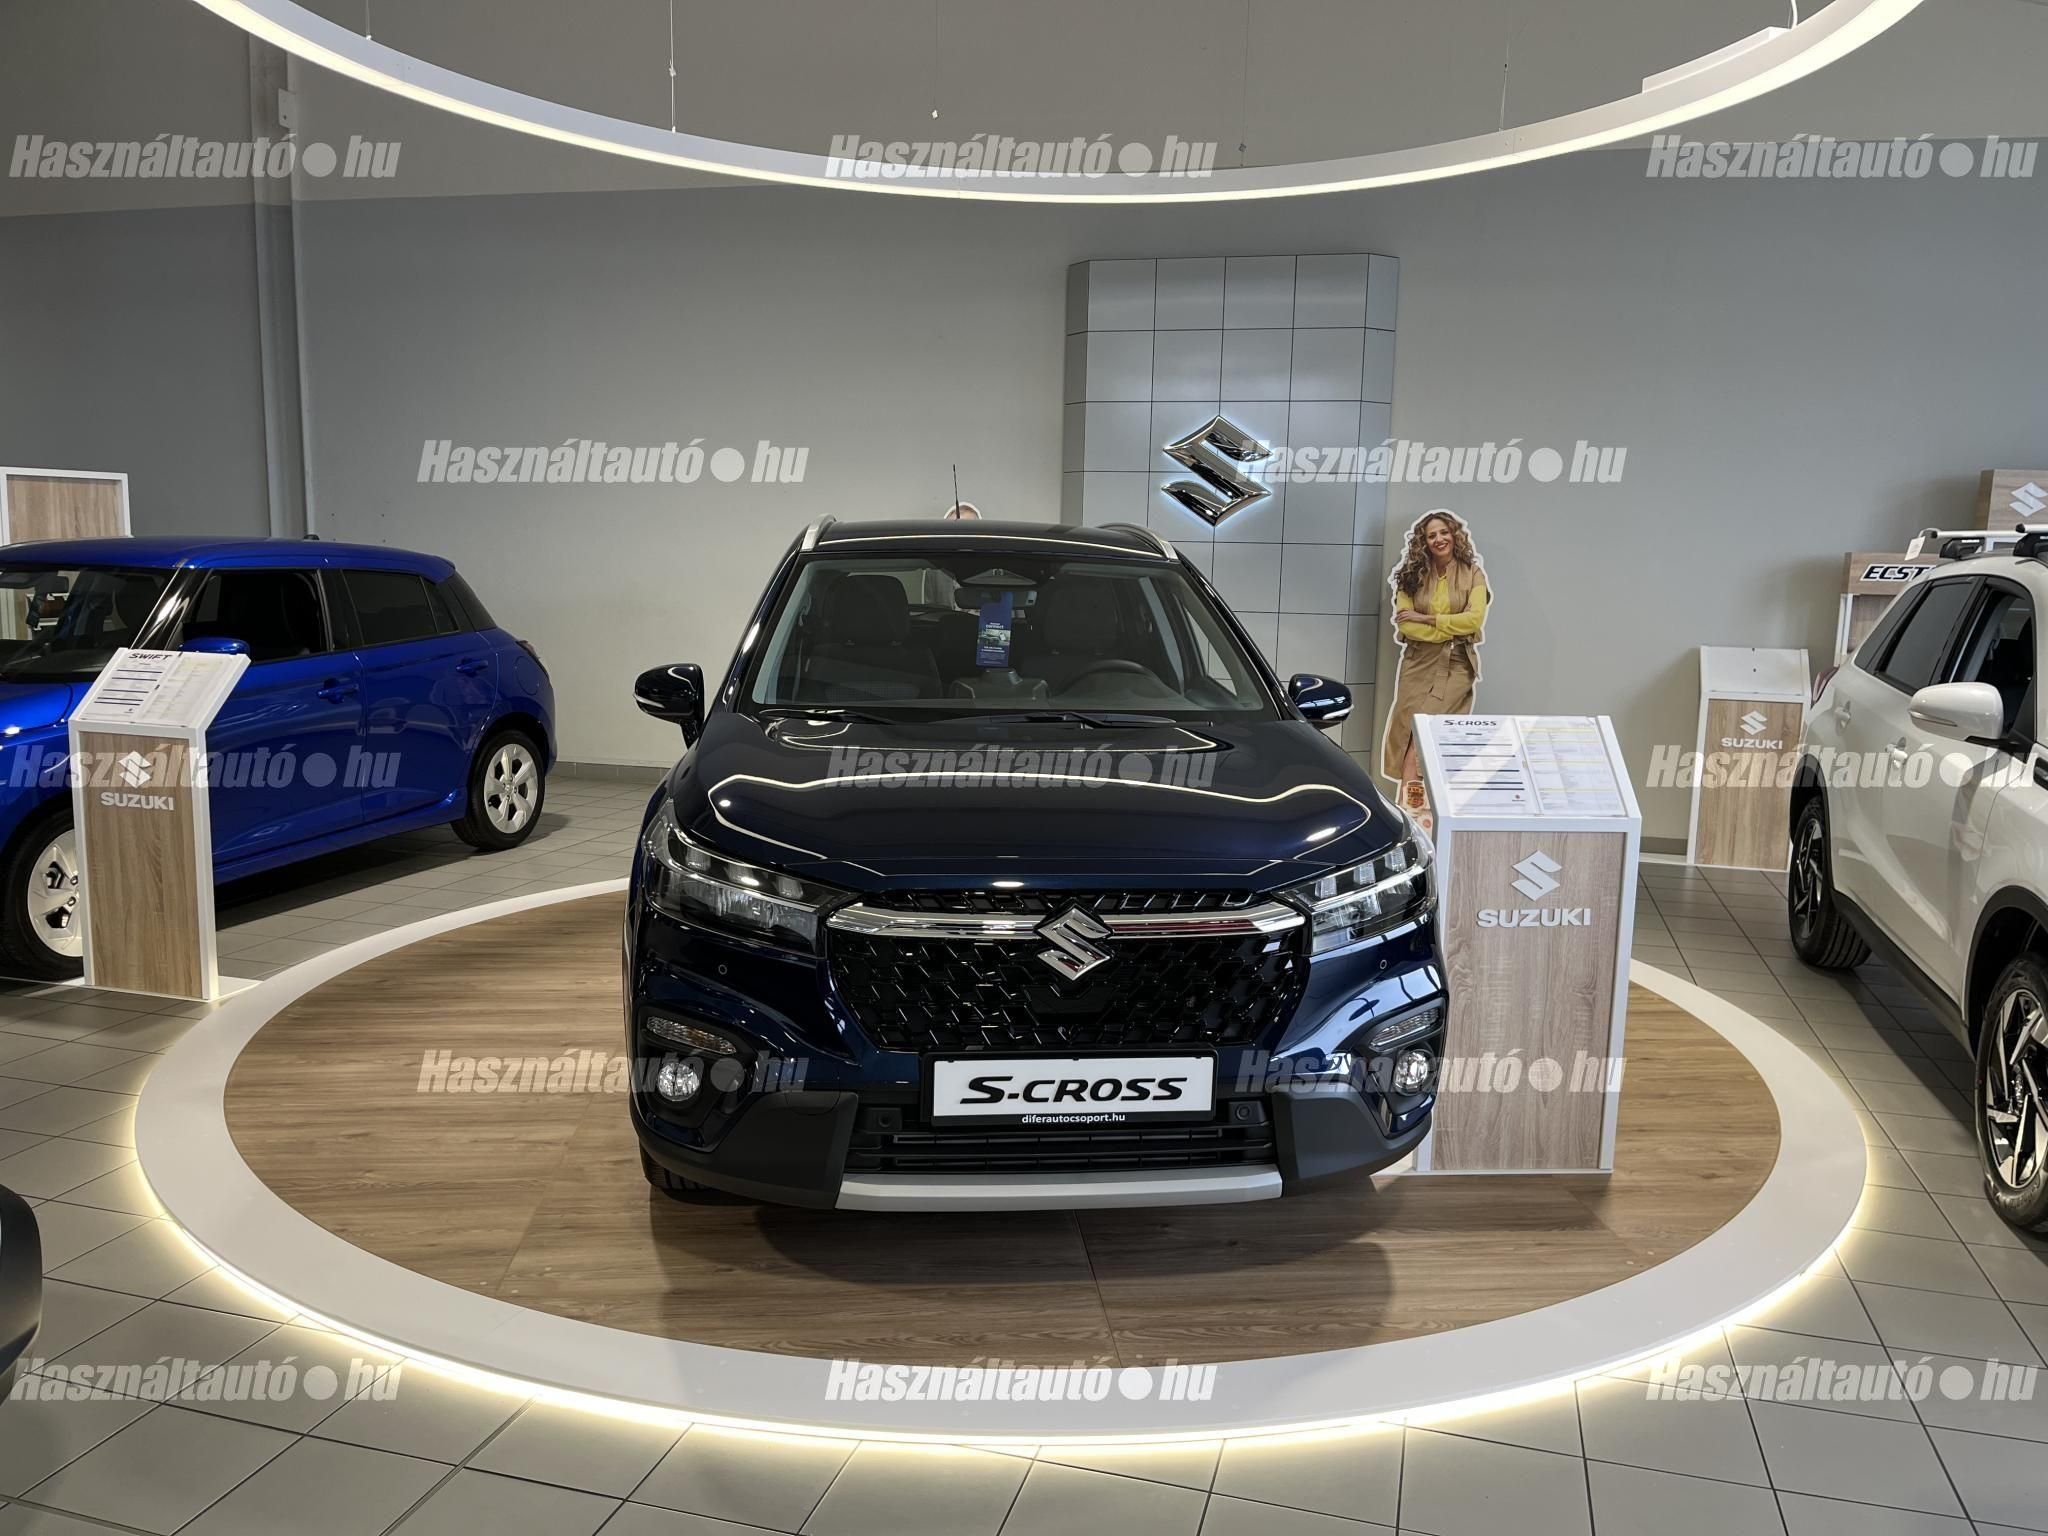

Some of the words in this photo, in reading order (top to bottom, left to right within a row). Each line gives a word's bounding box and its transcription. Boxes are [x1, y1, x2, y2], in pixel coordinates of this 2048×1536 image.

[128, 652, 173, 661] SWIFT
[1443, 719, 1498, 727] S-CROSS
[1721, 737, 1784, 751] SUZUKI
[100, 791, 175, 811] SUZUKI
[1476, 907, 1592, 928] SUZUKI
[959, 1075, 1188, 1105] S-CROSS
[1021, 1112, 1126, 1125] diferautocsoport.hu
